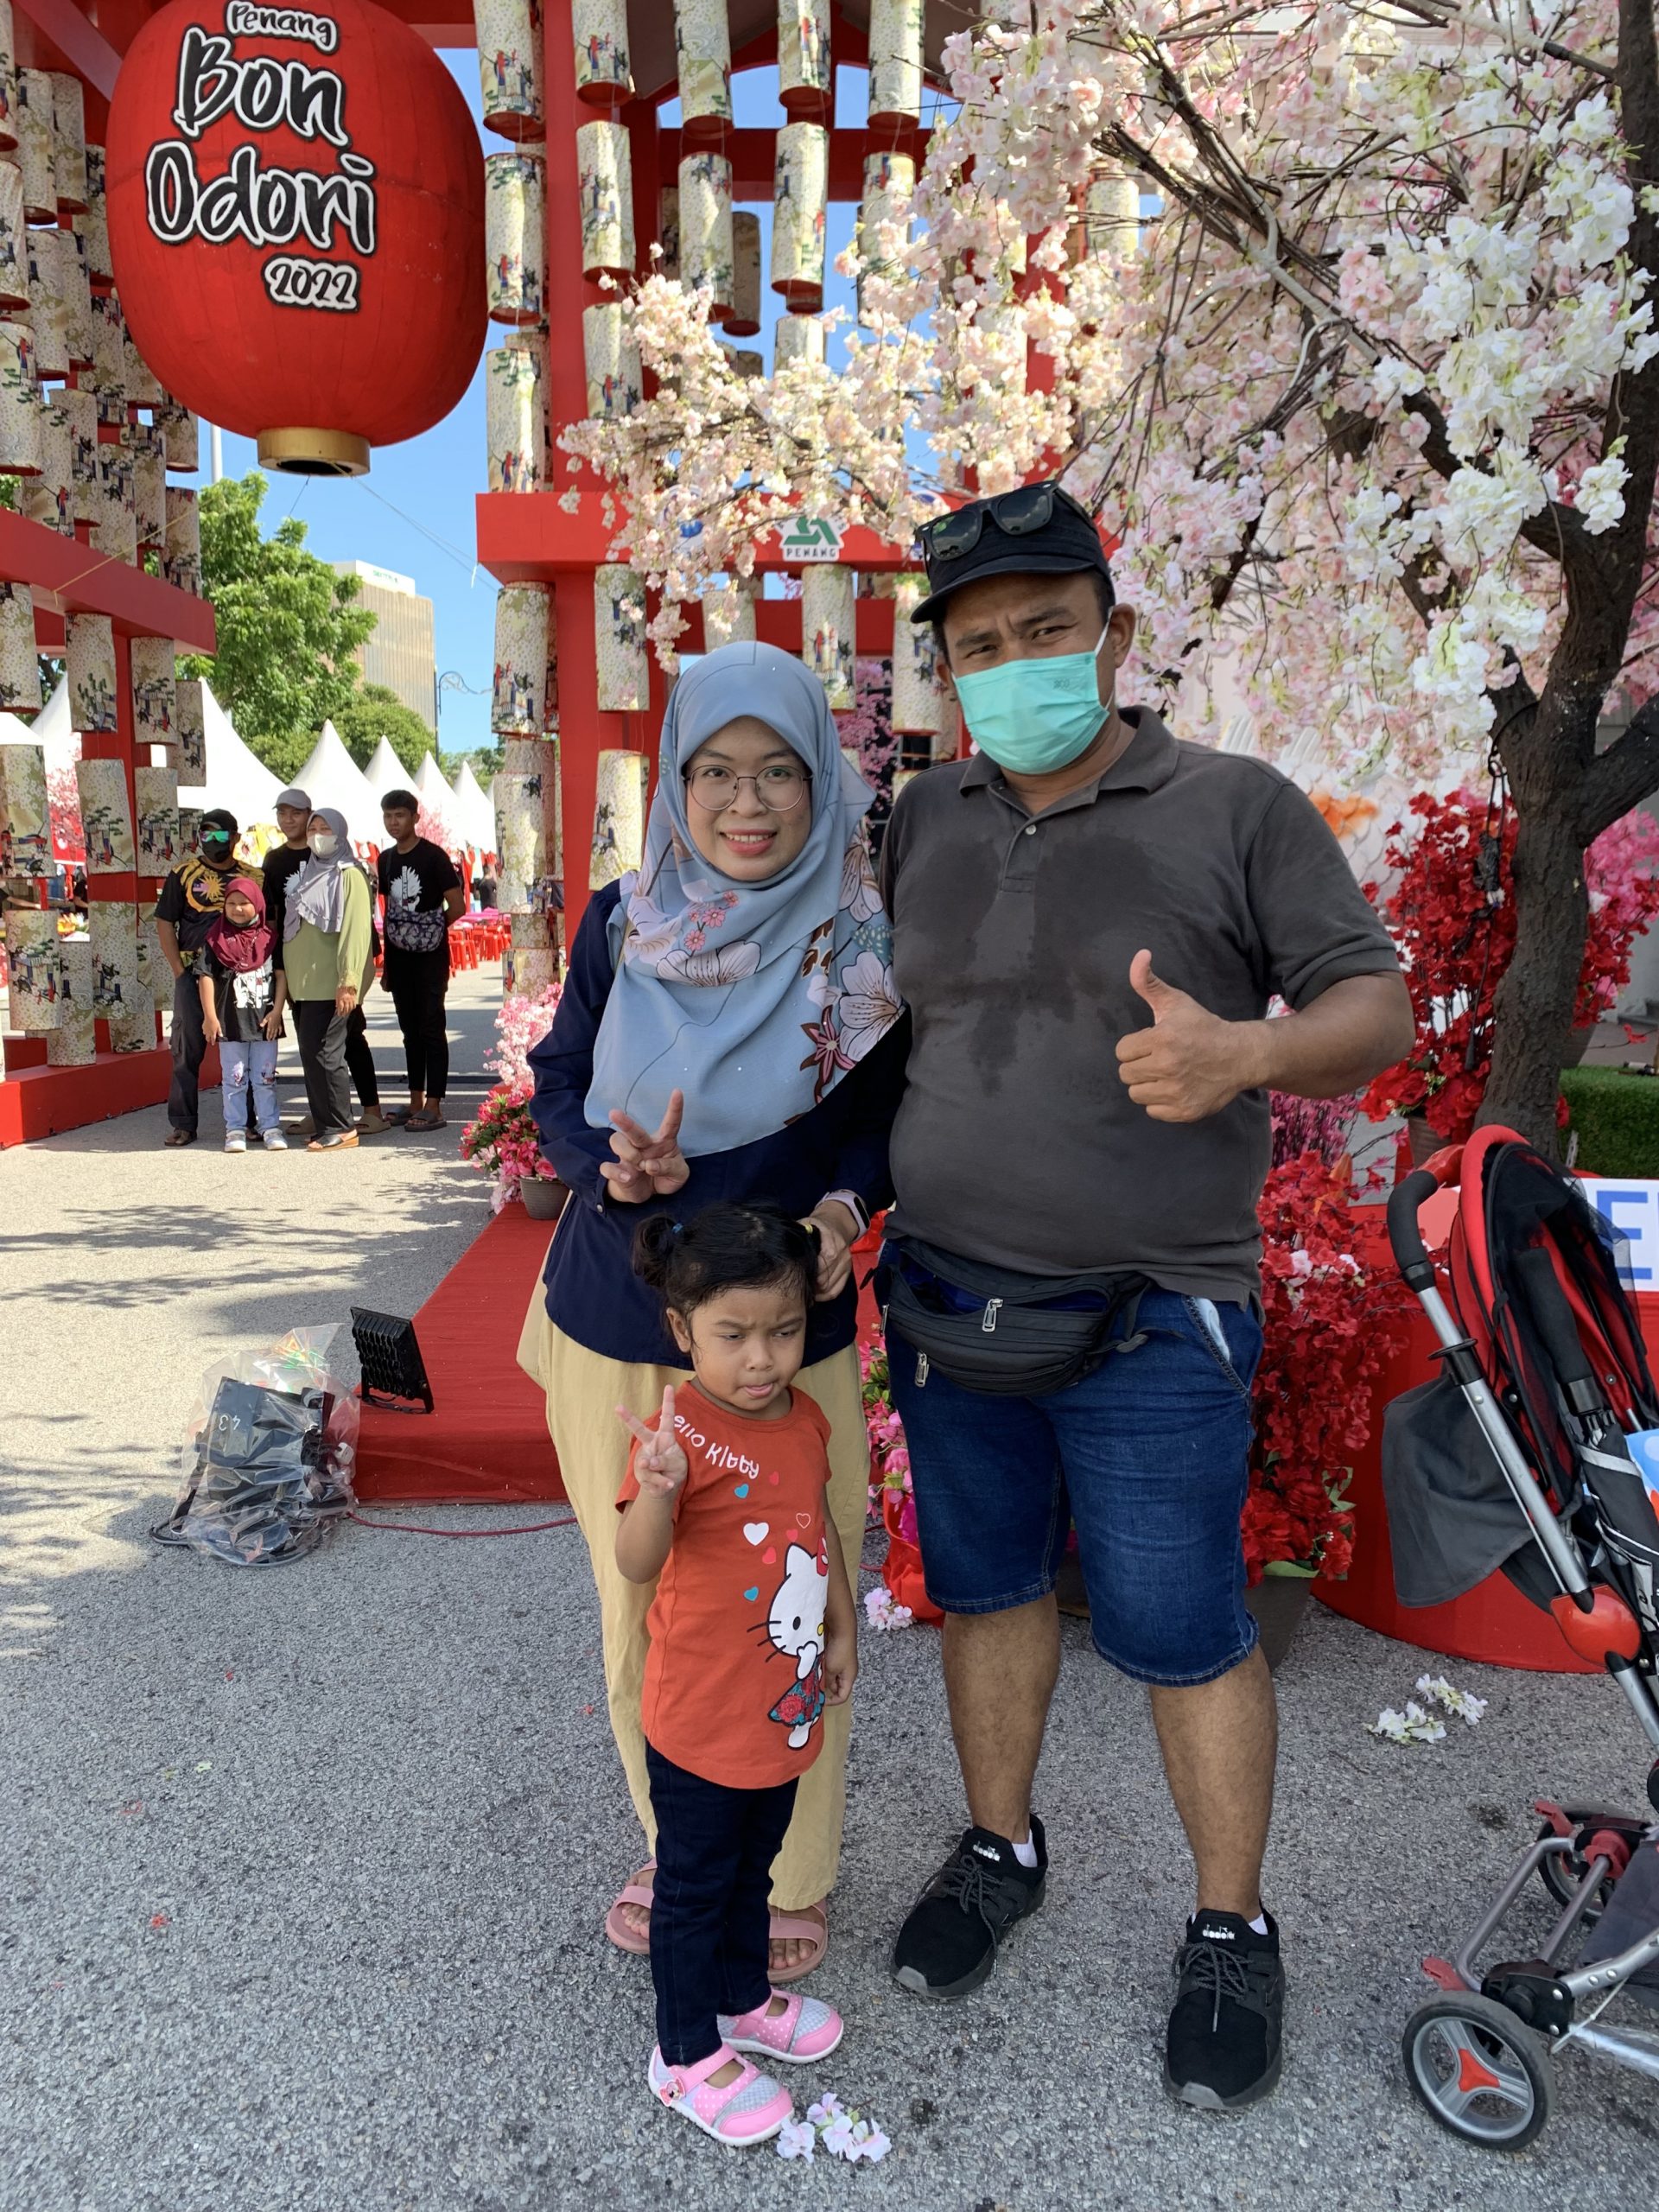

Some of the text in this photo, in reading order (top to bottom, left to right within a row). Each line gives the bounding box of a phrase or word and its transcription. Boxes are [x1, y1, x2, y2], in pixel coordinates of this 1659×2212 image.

[227, 2, 336, 51] Penang
[175, 29, 347, 145] Bon
[146, 142, 375, 253] Odori
[265, 259, 357, 309] 2022
[785, 547, 836, 558] PENANG
[672, 1414, 706, 1448] ello
